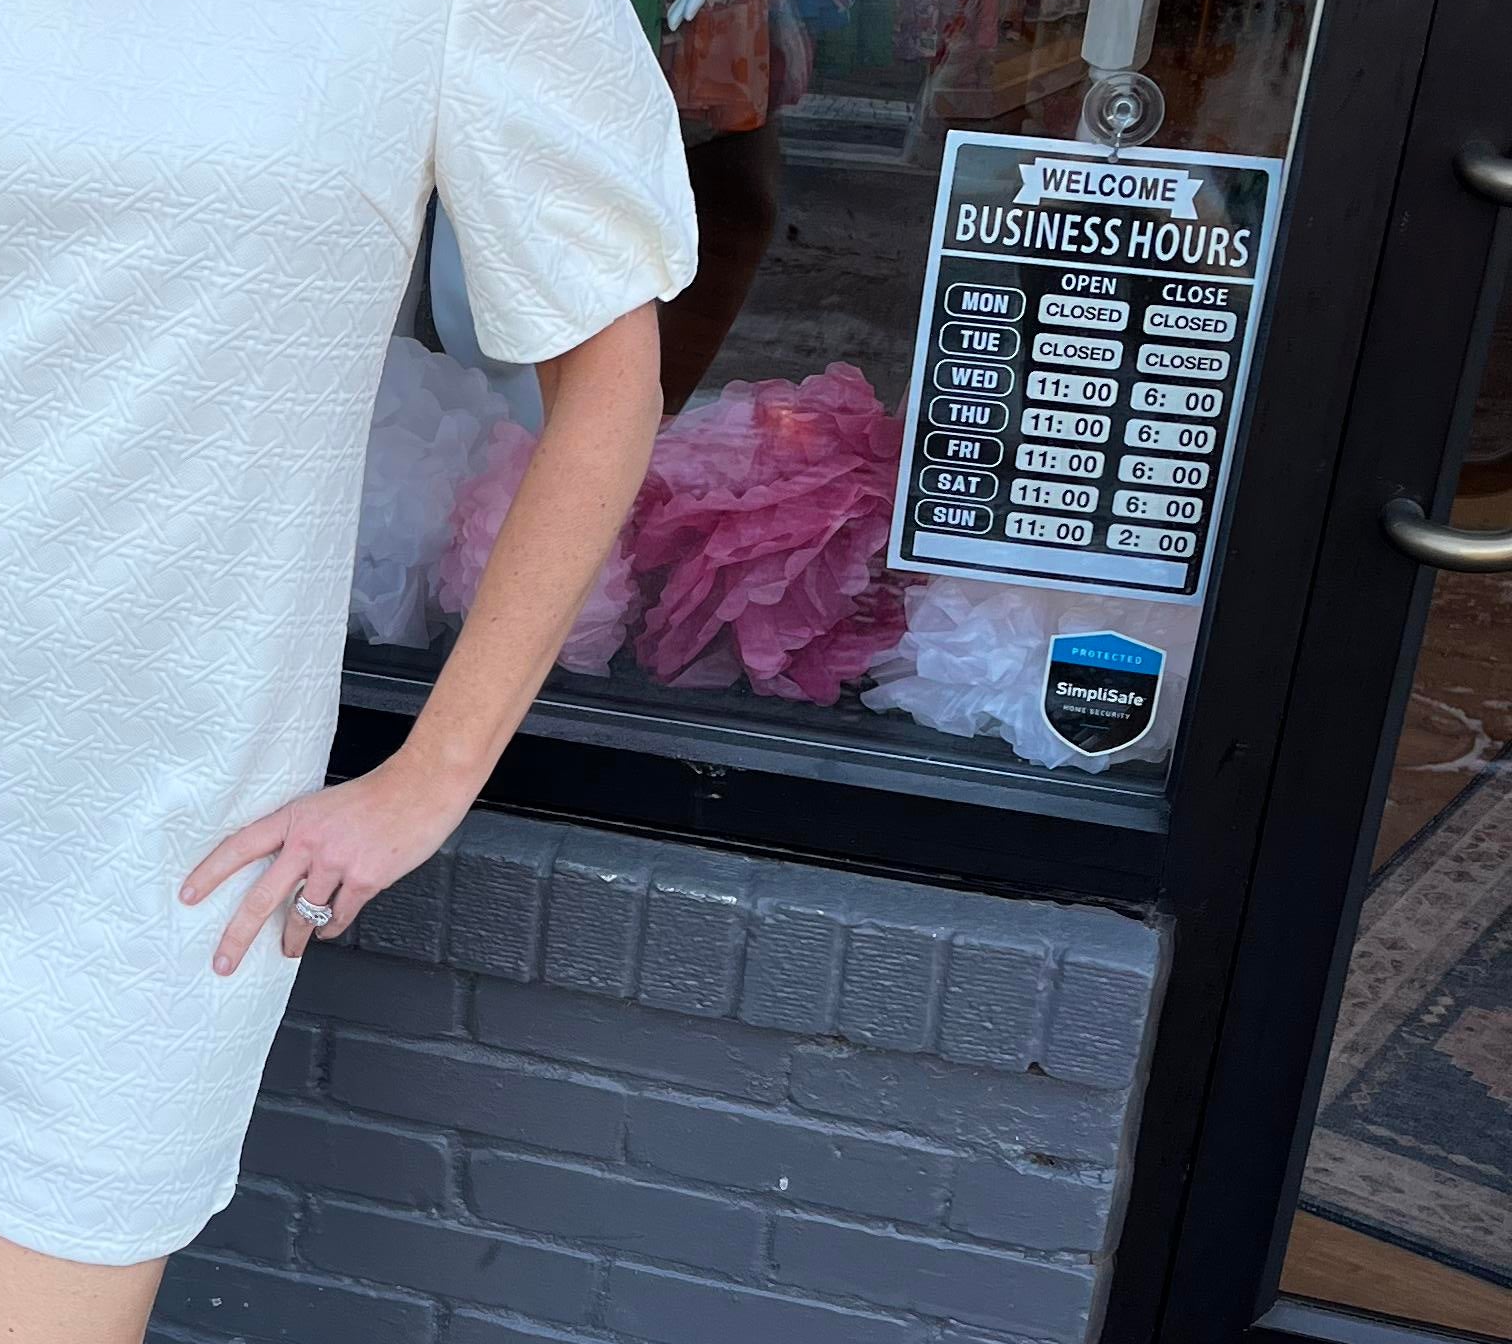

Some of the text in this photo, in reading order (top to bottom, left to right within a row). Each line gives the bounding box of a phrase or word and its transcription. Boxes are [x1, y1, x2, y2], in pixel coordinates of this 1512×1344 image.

[1042, 167, 1178, 202] WELCOME
[955, 203, 1251, 268] BUSINESS HOURS
[1061, 273, 1230, 306] OPEN CLOSE
[961, 291, 1228, 334] MON CLOSED CLOSED
[960, 330, 1223, 373] TUE CLOSED CLOSED
[951, 367, 999, 389] WED
[948, 404, 990, 425] THU
[947, 439, 981, 459] FRI
[937, 473, 981, 494] SAT
[932, 507, 976, 527] SUN
[1071, 647, 1143, 665] PROTECTED
[1055, 681, 1145, 706] SimpliSafe
[1063, 705, 1131, 720] HOME SECURITY
